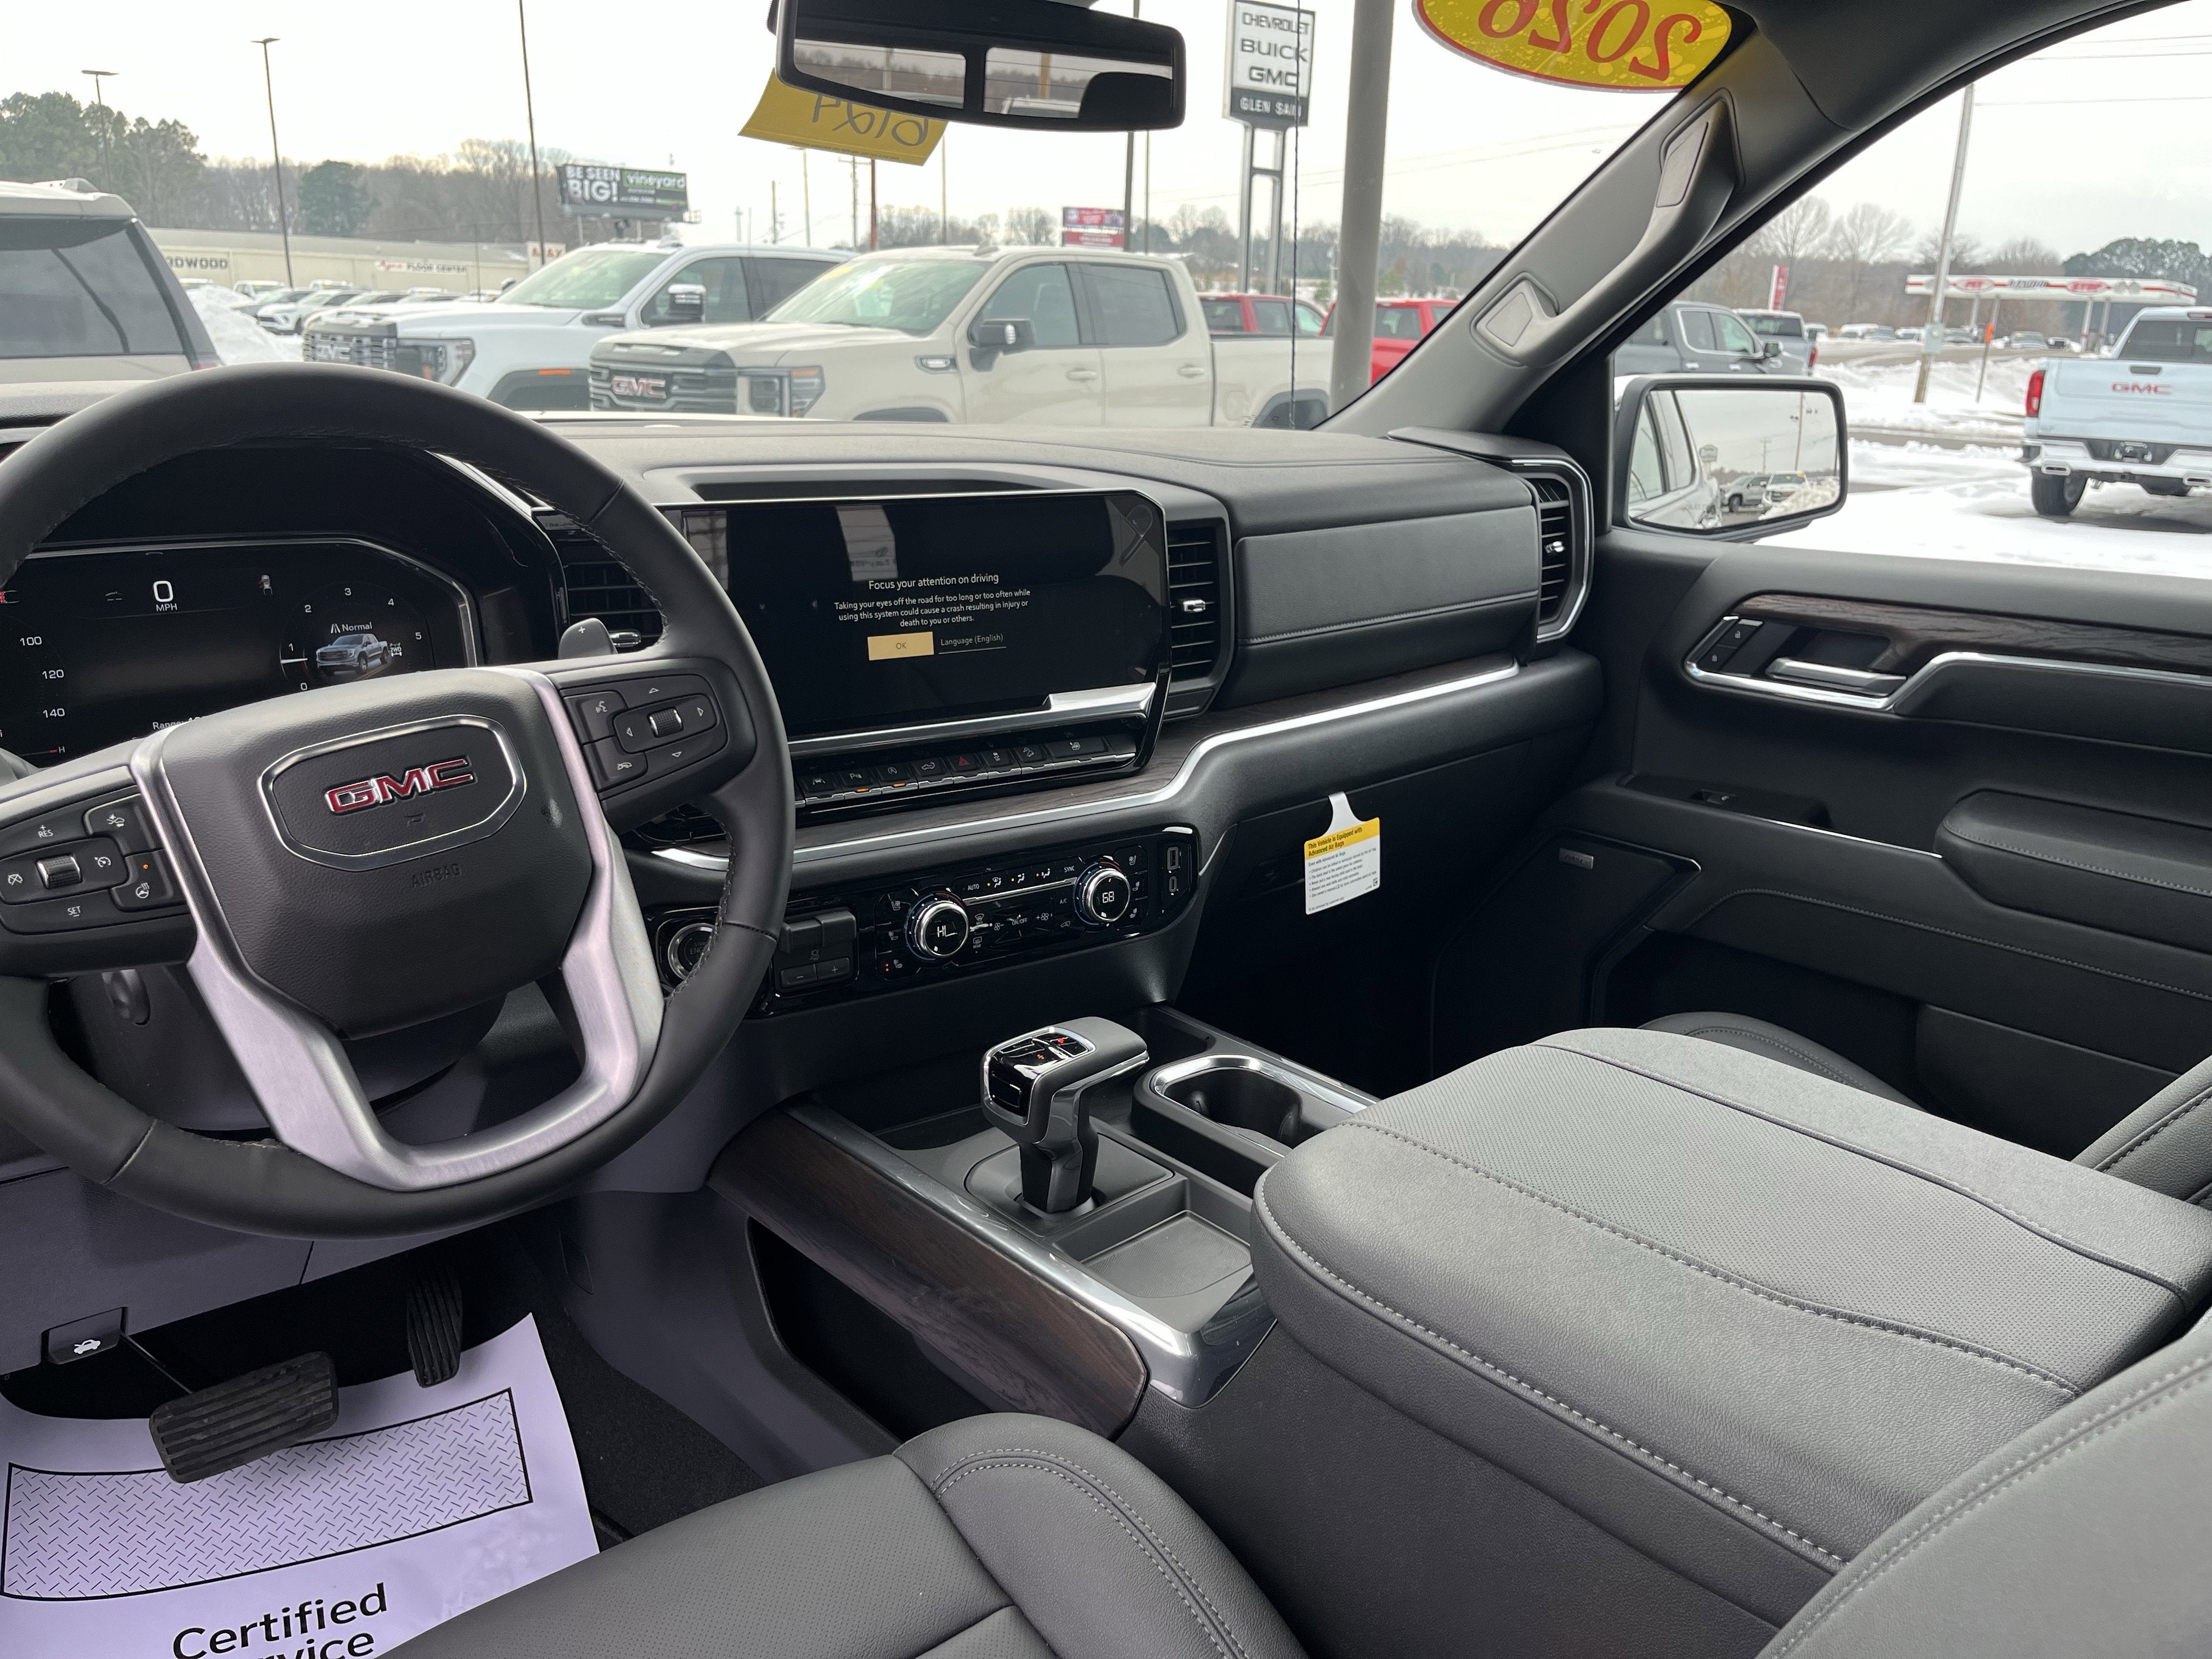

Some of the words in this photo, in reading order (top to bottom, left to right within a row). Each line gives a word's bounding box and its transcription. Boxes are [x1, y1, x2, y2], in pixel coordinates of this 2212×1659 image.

[1243, 12, 1310, 35] CHEVROLET
[1241, 38, 1308, 62] BUICK
[1249, 65, 1300, 87] GMC
[1240, 97, 1271, 114] GLEN
[566, 165, 584, 179] BE
[586, 167, 621, 182] SEEN
[627, 171, 685, 190] vineyard
[566, 179, 619, 202] BIG!
[611, 375, 667, 399] GMC
[2111, 382, 2172, 396] GMC
[869, 580, 895, 590] Focus
[897, 580, 916, 591] your
[918, 576, 956, 587] attention
[970, 573, 999, 584] driving
[153, 580, 173, 602] 0
[345, 588, 352, 596] 3
[156, 603, 178, 612] MPH
[834, 602, 857, 611] Taking
[859, 601, 874, 610] your
[876, 600, 892, 608] eyes
[894, 597, 905, 606] off
[918, 596, 933, 604] road
[935, 595, 945, 603] for
[958, 594, 973, 602] long
[1014, 589, 1031, 597] while
[304, 605, 312, 613] 2
[839, 613, 859, 622] using
[860, 611, 873, 619] this
[874, 610, 899, 620] system
[900, 607, 919, 616] could
[920, 606, 940, 614] cause
[946, 604, 964, 613] crash
[966, 602, 994, 611] resulting
[1002, 601, 1020, 610] injury
[342, 622, 373, 632] Normal
[900, 619, 919, 628] death
[929, 619, 942, 627] you
[951, 614, 975, 623] others.
[20, 636, 42, 646] 100
[288, 643, 294, 651] 1
[940, 637, 973, 647] Language
[974, 633, 1003, 645] (English)
[42, 669, 64, 680] 120
[300, 682, 308, 691] 0
[43, 708, 65, 718] 140
[324, 758, 474, 812] GMC
[38, 830, 54, 838] RES
[1317, 837, 1332, 847] Vehicle
[1336, 829, 1354, 842] Equipped
[1308, 846, 1328, 856] Advanced
[1335, 840, 1344, 849] Bags
[412, 864, 461, 888] AIRBAG
[1102, 891, 1114, 903] 68
[67, 906, 81, 916] SET
[1012, 917, 1028, 926] ON/OFF
[173, 1582, 387, 1659] Certified
